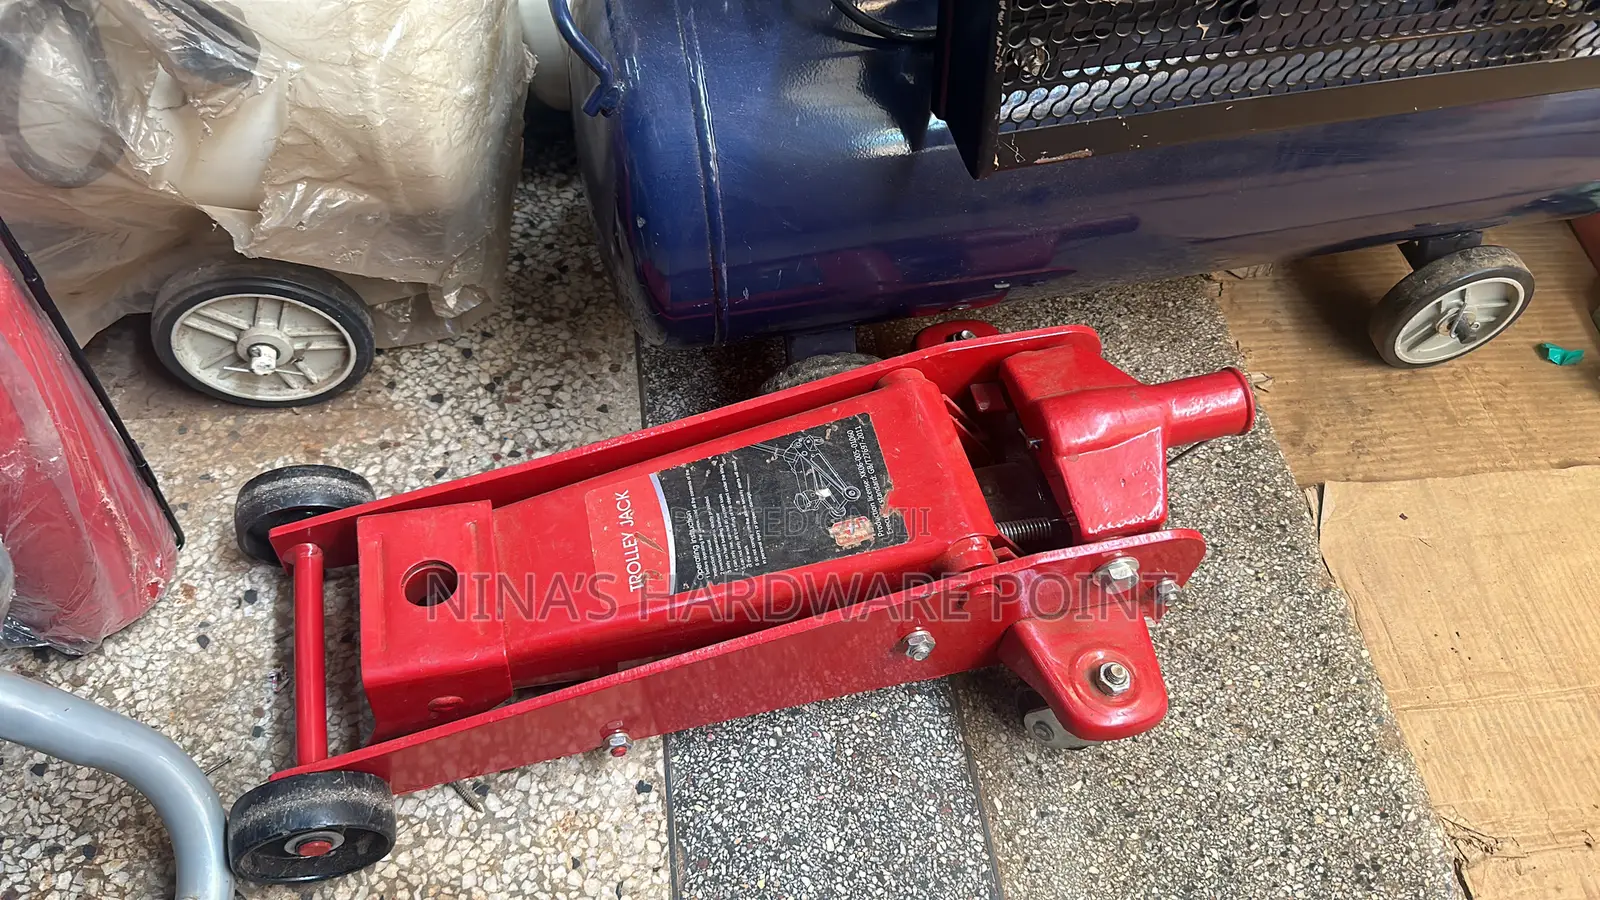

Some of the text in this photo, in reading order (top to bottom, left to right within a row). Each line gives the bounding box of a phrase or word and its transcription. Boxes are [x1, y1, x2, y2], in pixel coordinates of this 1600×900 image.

[855, 426, 874, 474] GB/T27697-2011
[863, 479, 874, 502] license:
[870, 502, 884, 536] Production
[615, 490, 644, 592] TROLLEY JACK
[693, 545, 706, 580] Operating
